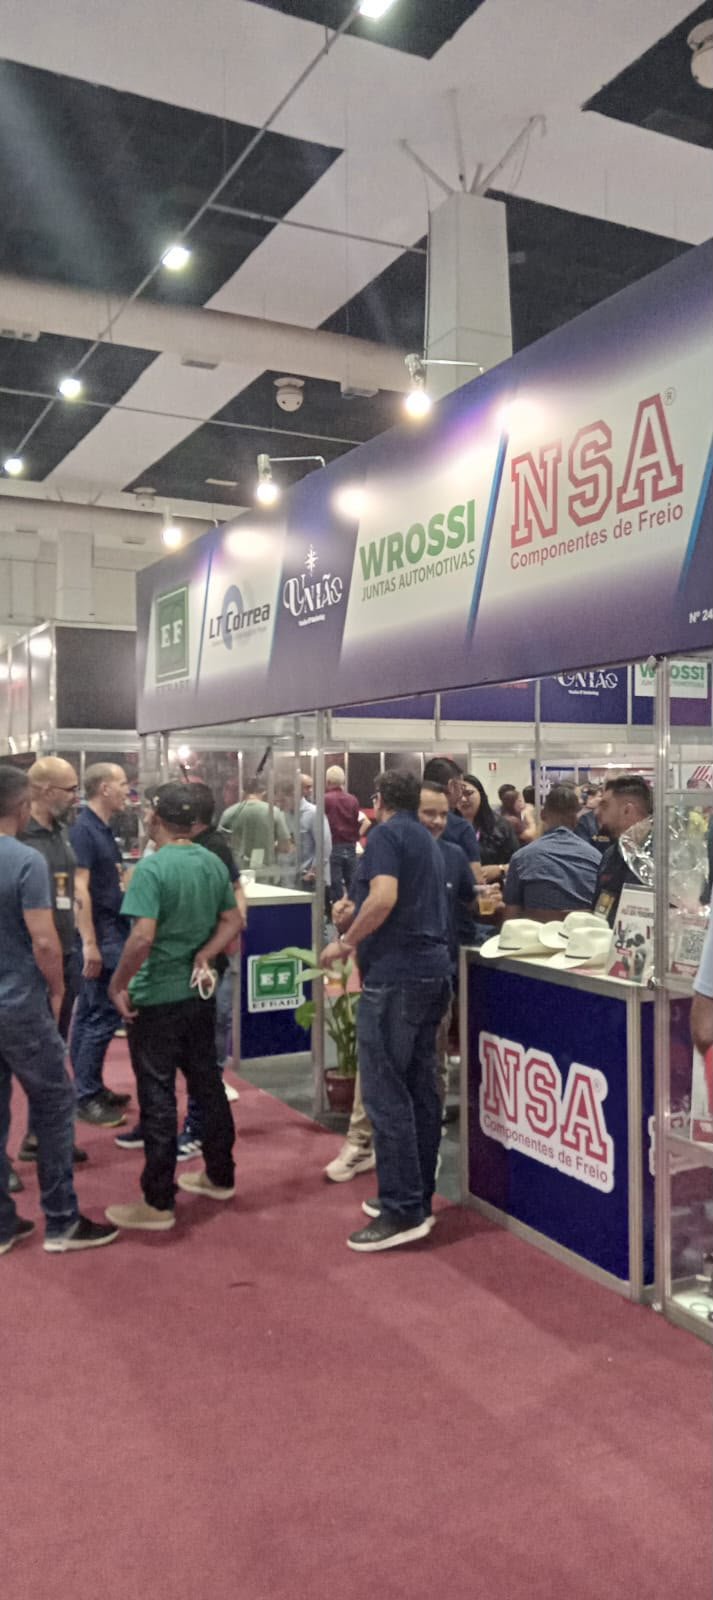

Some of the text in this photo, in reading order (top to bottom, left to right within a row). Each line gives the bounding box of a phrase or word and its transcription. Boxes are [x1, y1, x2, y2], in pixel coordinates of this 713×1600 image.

[510, 393, 684, 549] NSA
[359, 499, 476, 580] WROSSI
[510, 503, 684, 570] Componentes de Freio
[361, 549, 476, 602] JUNTAS AUTOMOTIVAS
[160, 618, 183, 648] EF
[209, 615, 223, 639] LT
[225, 603, 271, 633] Correa
[640, 663, 705, 681] WOSSI
[259, 972, 292, 987] EF
[483, 1040, 608, 1163] NSA
[483, 1114, 608, 1184] Componentes de Freio
